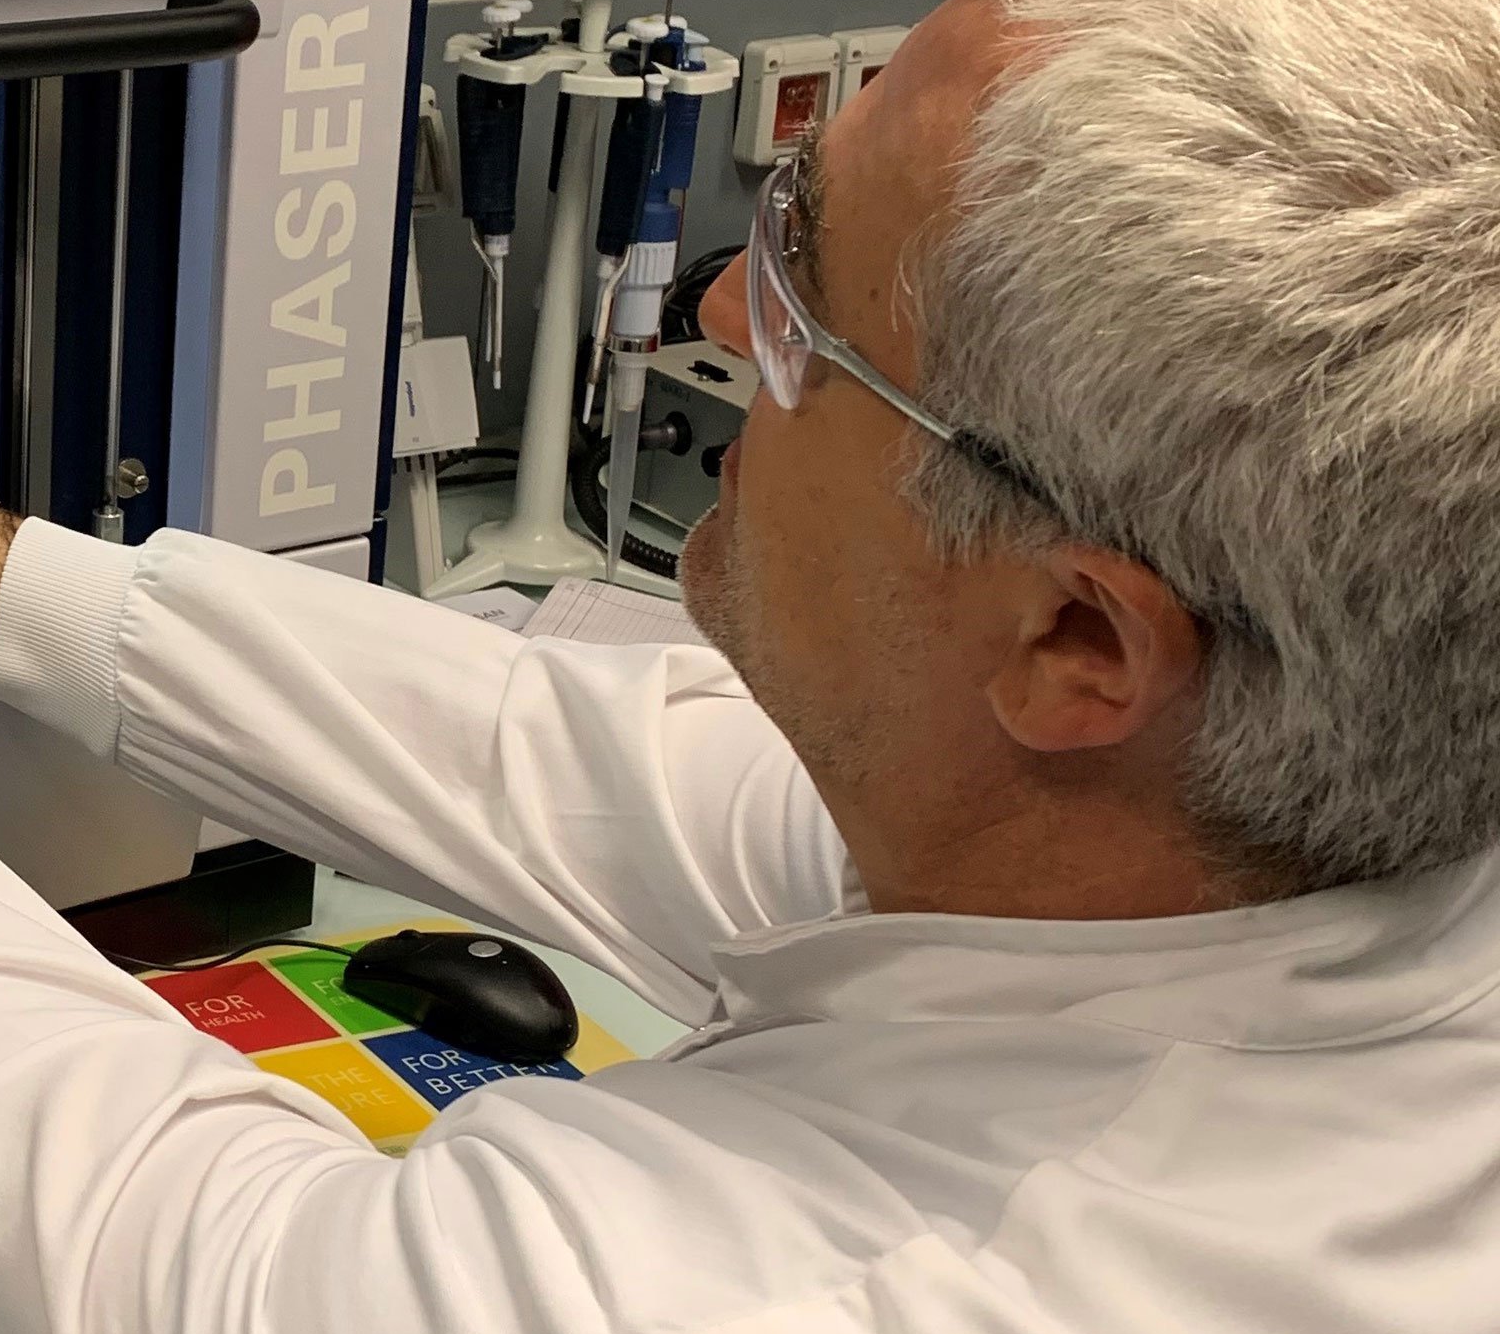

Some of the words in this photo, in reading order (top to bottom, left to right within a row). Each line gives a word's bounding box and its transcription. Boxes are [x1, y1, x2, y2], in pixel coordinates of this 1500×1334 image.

[258, 4, 371, 518] PHASER
[185, 993, 254, 1019] FOR
[201, 1008, 265, 1030] HEALTH
[400, 1048, 470, 1074] FOR
[309, 1066, 372, 1090] THE
